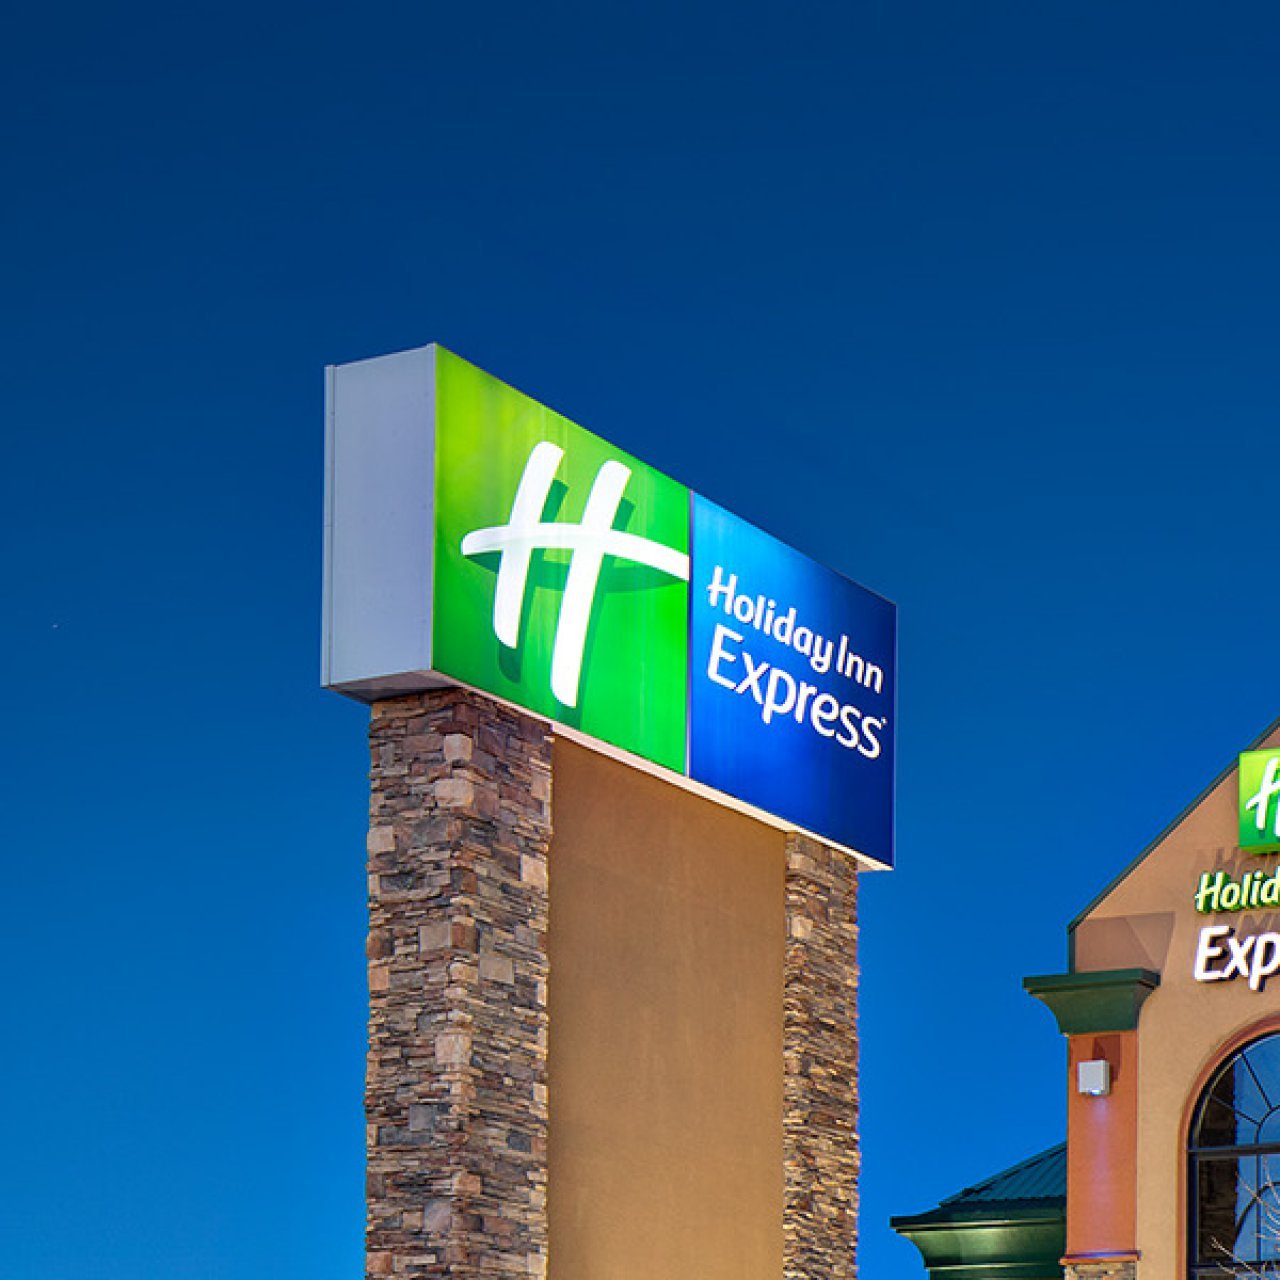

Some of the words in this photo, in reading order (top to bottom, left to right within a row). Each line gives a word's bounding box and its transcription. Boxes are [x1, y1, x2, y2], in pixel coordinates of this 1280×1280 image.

[706, 564, 834, 675] Holiday
[836, 633, 884, 695] Inn
[707, 622, 883, 760] Express
